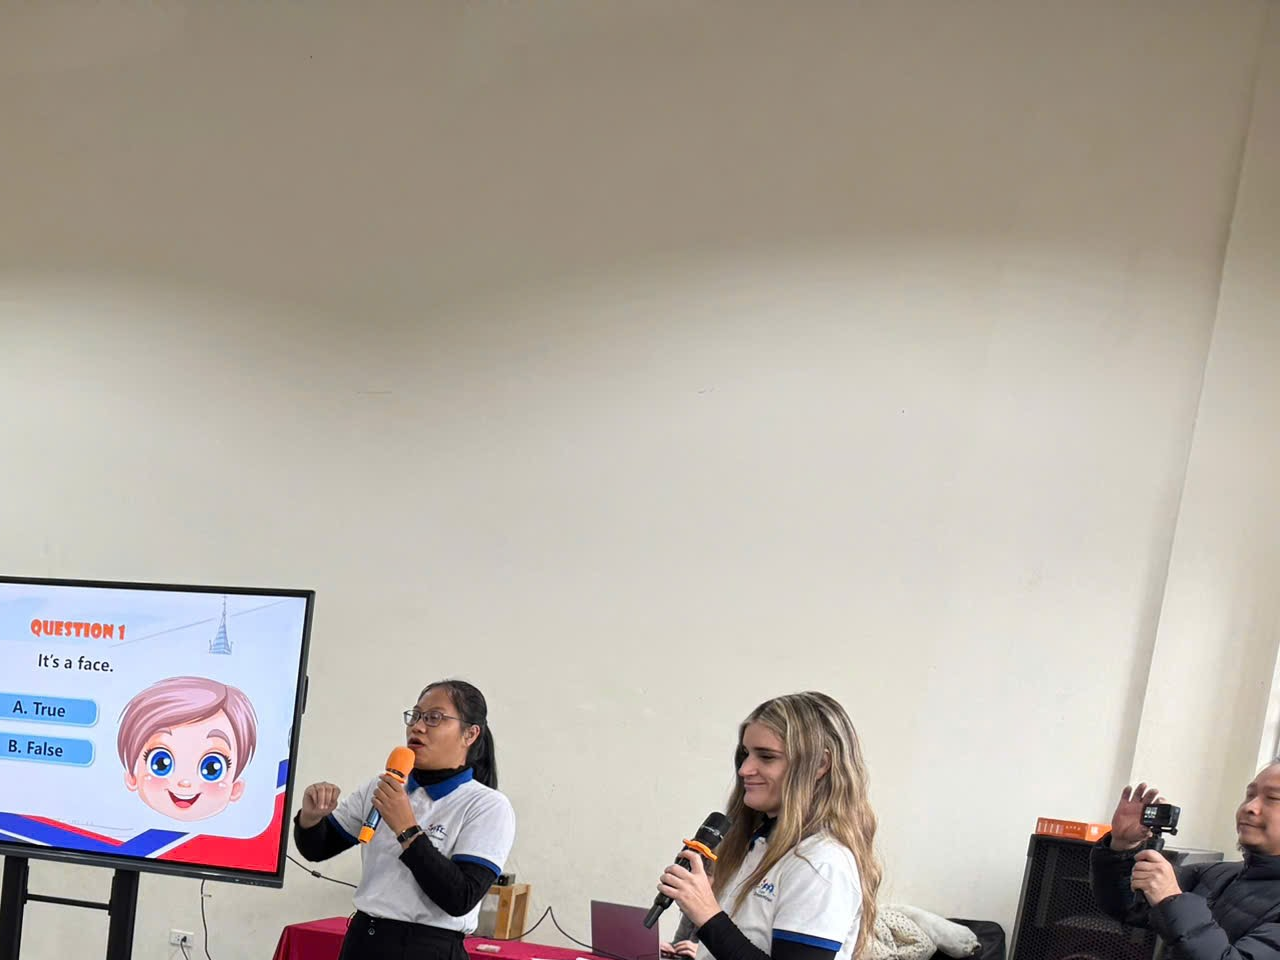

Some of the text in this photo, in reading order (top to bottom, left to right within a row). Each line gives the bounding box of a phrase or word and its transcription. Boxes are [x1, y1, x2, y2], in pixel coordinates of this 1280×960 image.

[31, 619, 126, 641] QUESTION 1
[64, 658, 72, 669] a
[78, 655, 114, 672] face.
[12, 700, 66, 718] A. True
[8, 739, 63, 757] B. False
